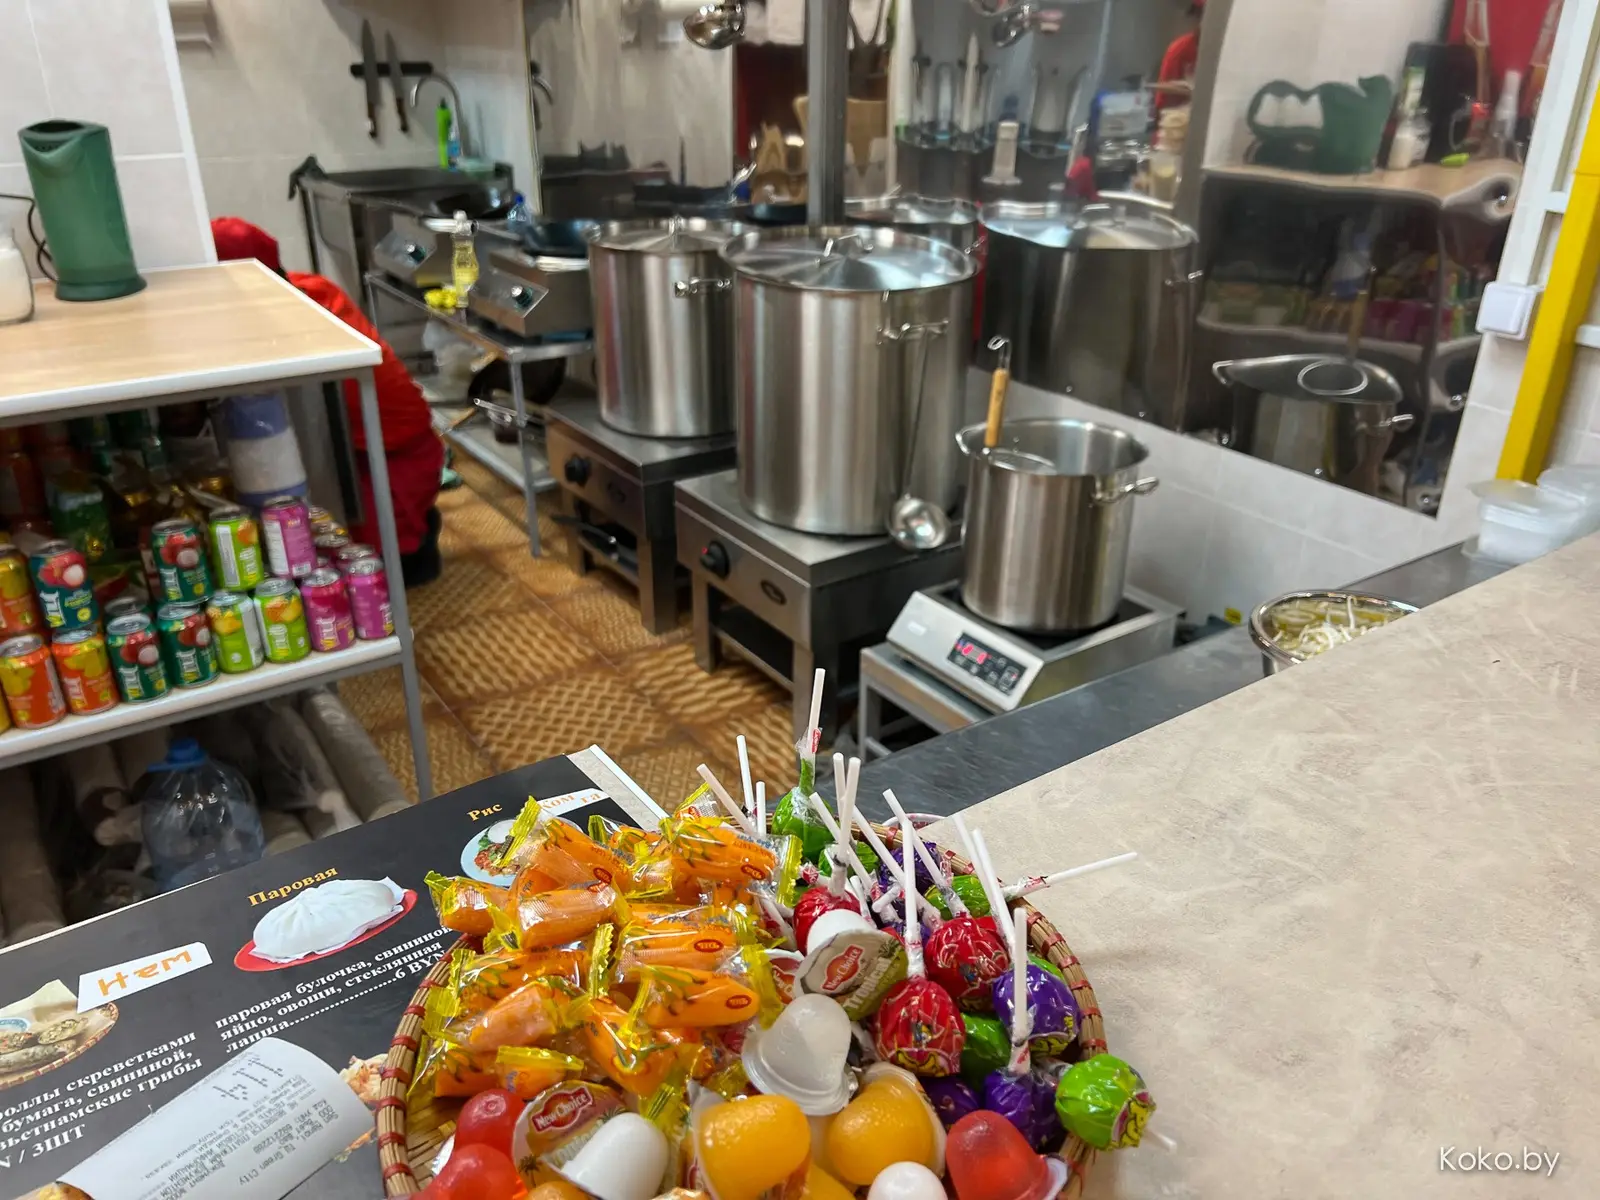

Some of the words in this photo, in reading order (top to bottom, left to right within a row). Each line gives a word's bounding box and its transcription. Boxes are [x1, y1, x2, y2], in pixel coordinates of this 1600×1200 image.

[467, 803, 503, 822] Рис
[247, 867, 339, 907] Паровая
[215, 991, 293, 1029] паровая
[295, 960, 373, 995] булочка,
[220, 1014, 274, 1042] яйцо,
[277, 985, 343, 1018] овощи,
[344, 942, 443, 988] стеклянная
[842, 956, 892, 1009] Tropical
[66, 1031, 197, 1092] скреветками
[137, 1058, 203, 1094] грибы
[213, 1056, 284, 1101] 114
[1, 1096, 83, 1134] бумага,
[86, 1047, 193, 1099] свининой,
[238, 1168, 260, 1186] City
